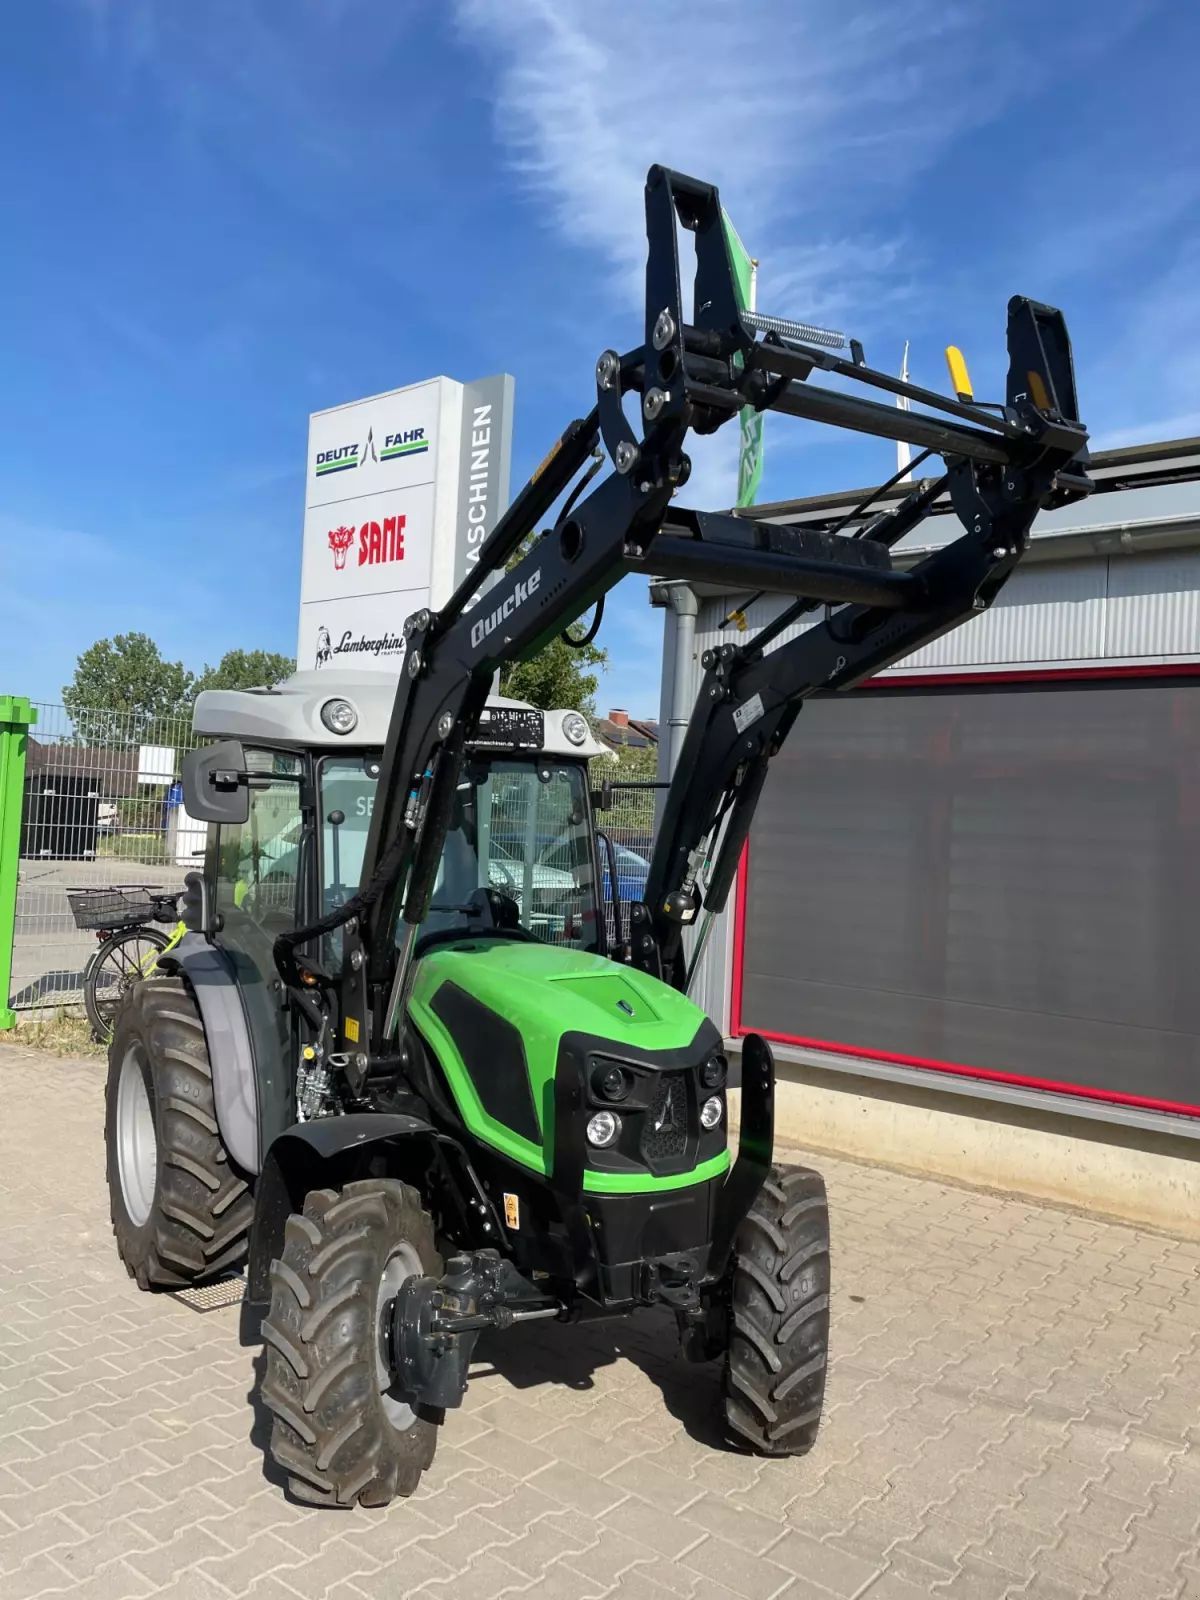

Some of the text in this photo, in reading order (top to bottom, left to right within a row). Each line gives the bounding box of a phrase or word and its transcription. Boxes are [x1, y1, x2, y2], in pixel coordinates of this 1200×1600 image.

[316, 427, 425, 464] DEUTZ FAHR
[358, 514, 406, 566] SAME
[471, 568, 541, 648] Quicke
[333, 630, 404, 656] Lamborghini
